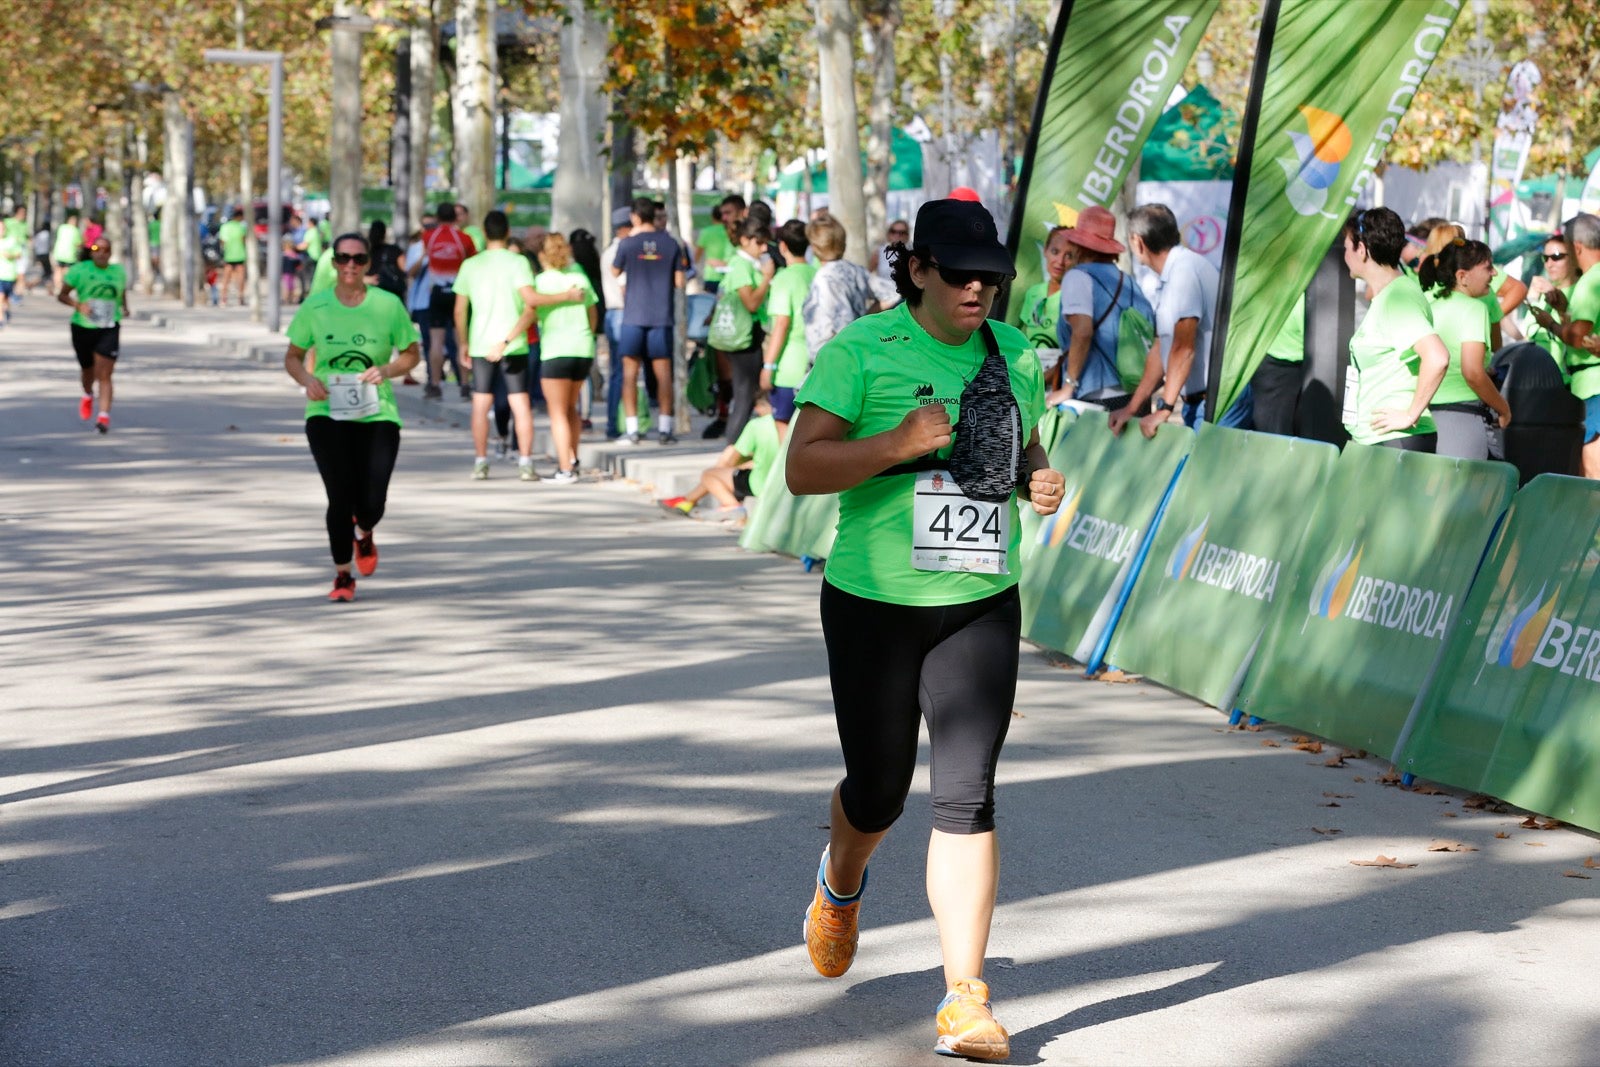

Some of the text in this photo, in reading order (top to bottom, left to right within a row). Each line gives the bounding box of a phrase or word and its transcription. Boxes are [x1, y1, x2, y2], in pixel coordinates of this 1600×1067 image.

[1077, 15, 1191, 207] IBERDROLA
[348, 389, 359, 406] 3
[929, 504, 1001, 543] 424
[1190, 541, 1281, 603] IBERDROLA
[1345, 576, 1454, 640] IBERDROLA
